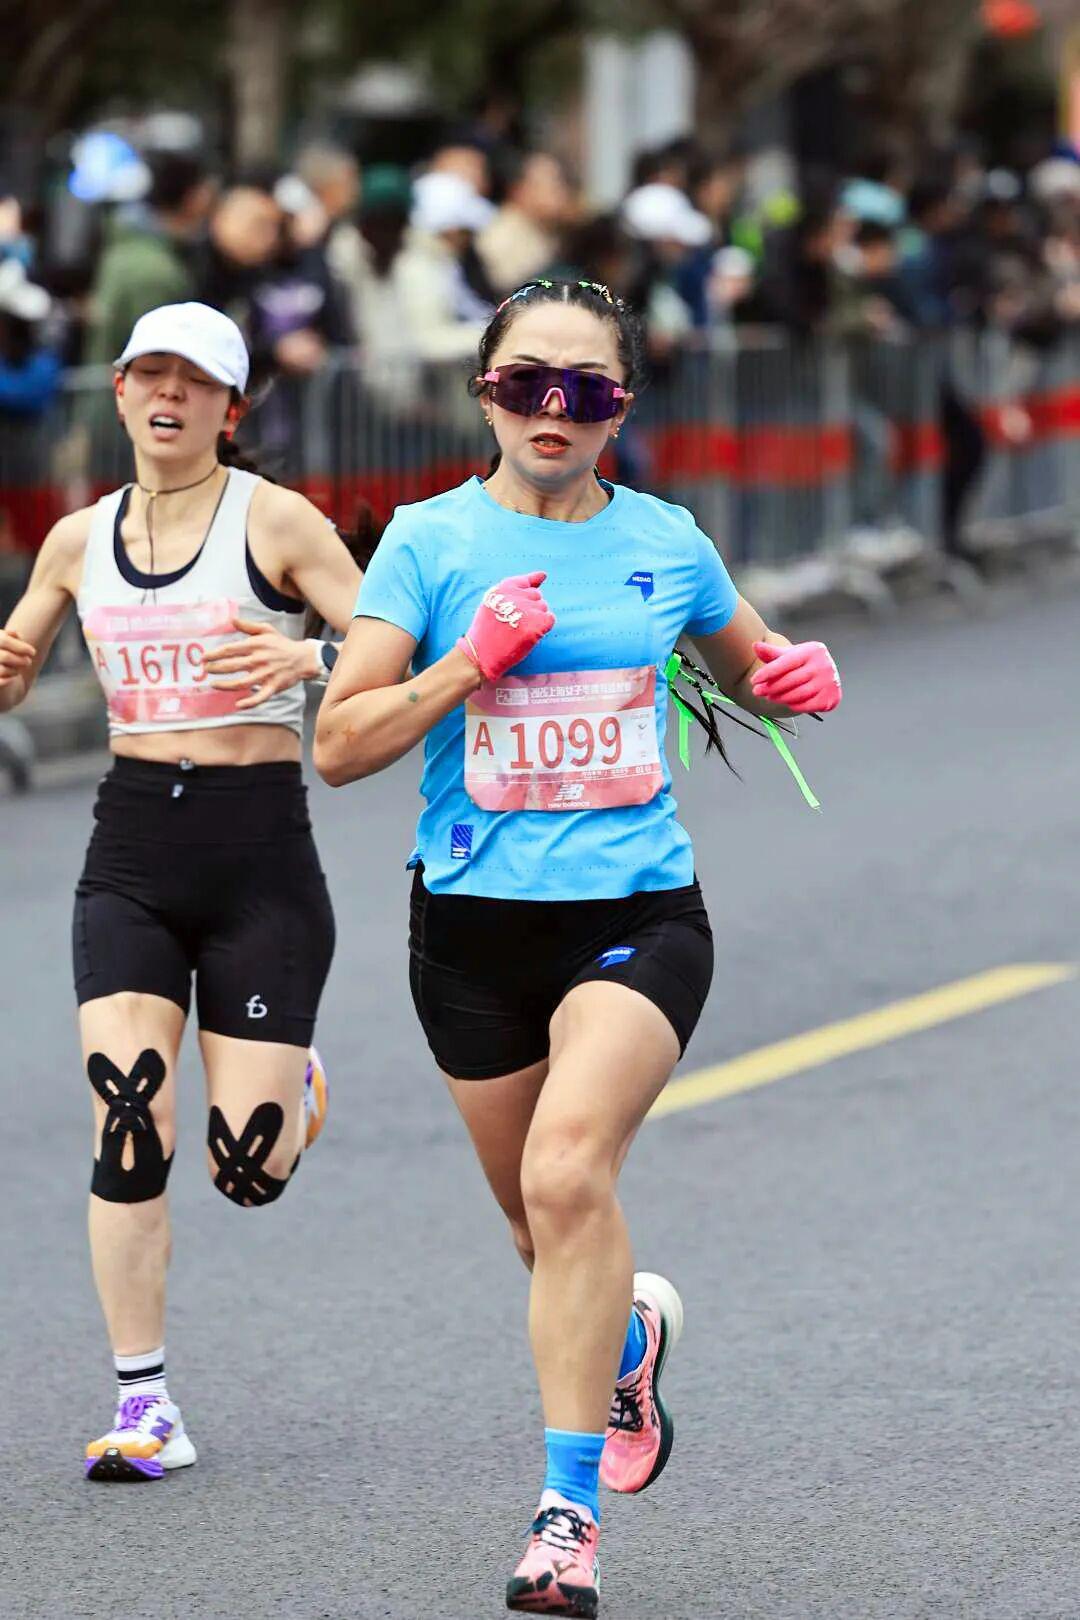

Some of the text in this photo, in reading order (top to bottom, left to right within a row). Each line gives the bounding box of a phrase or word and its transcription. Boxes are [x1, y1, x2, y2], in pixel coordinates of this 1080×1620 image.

[95, 641, 209, 686] A 1679
[472, 716, 622, 770] A 1099
